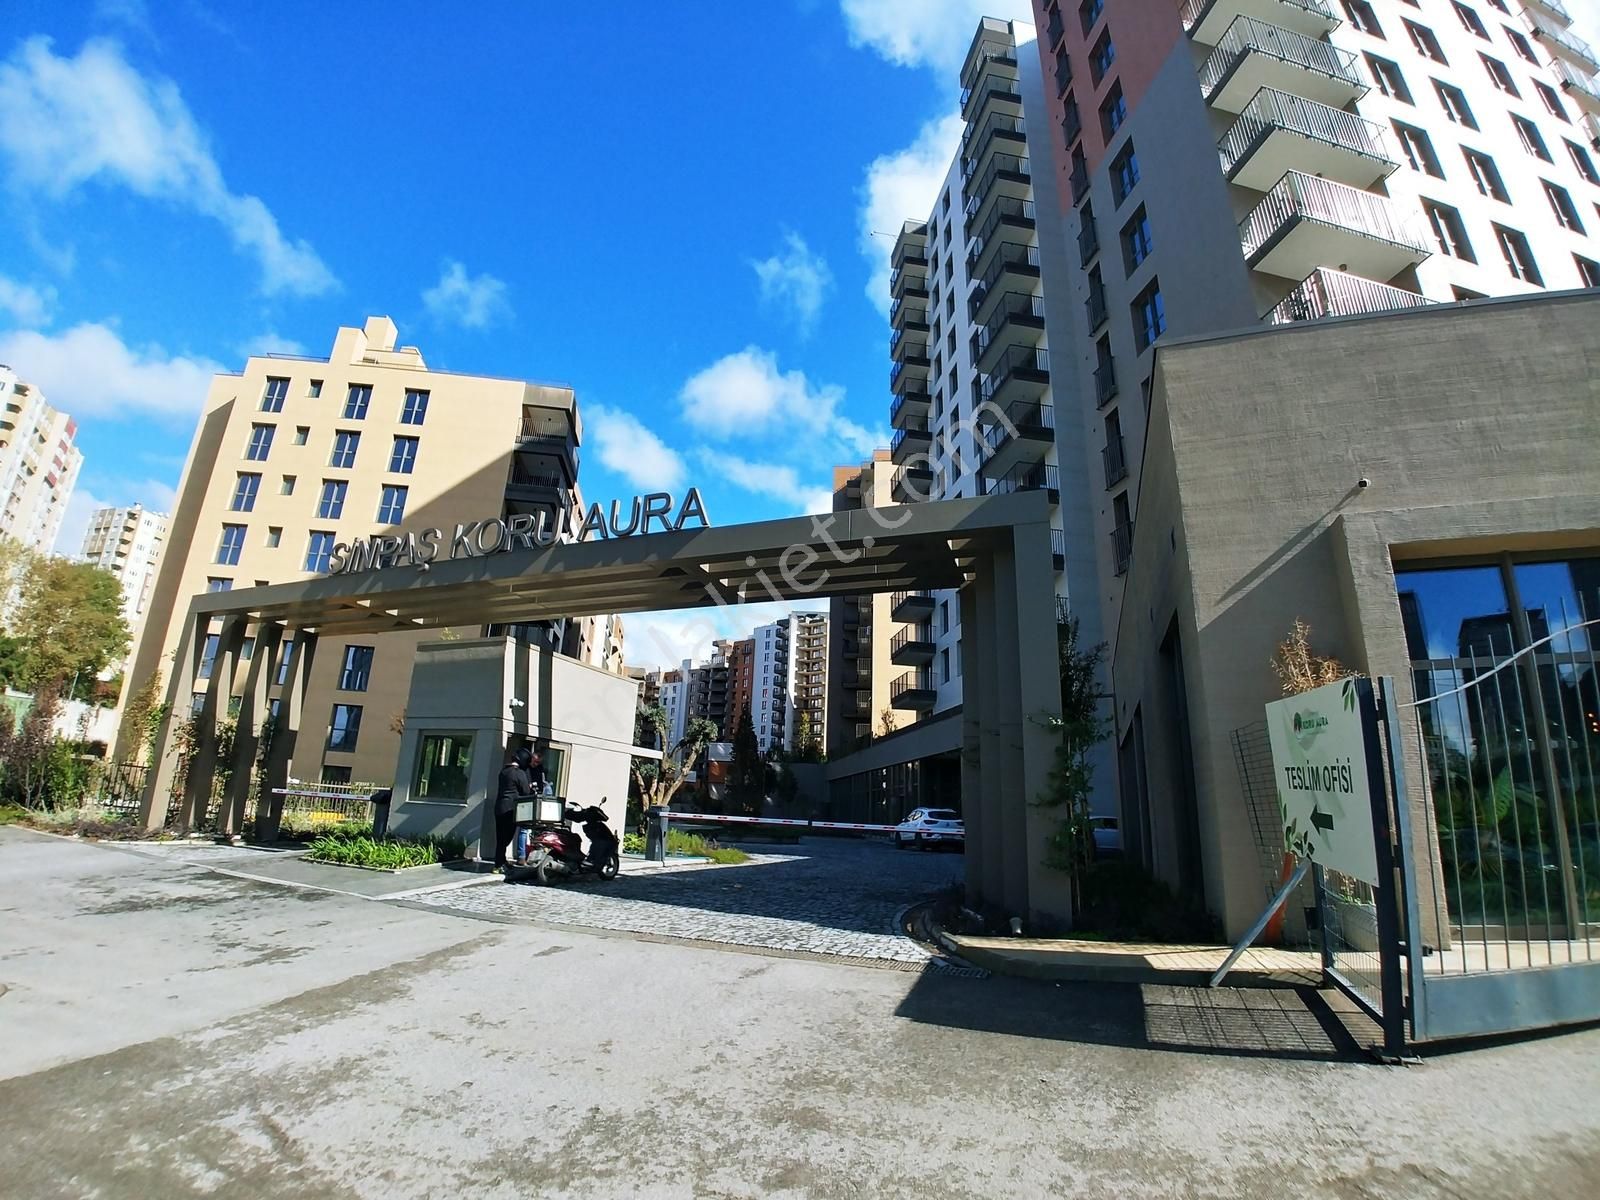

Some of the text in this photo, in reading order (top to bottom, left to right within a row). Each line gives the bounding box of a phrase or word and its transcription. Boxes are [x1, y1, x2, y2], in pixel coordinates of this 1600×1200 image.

[328, 487, 711, 574] SİNPAŞ KORU AURA
[1284, 757, 1354, 794] TESLİM OFİSİ
